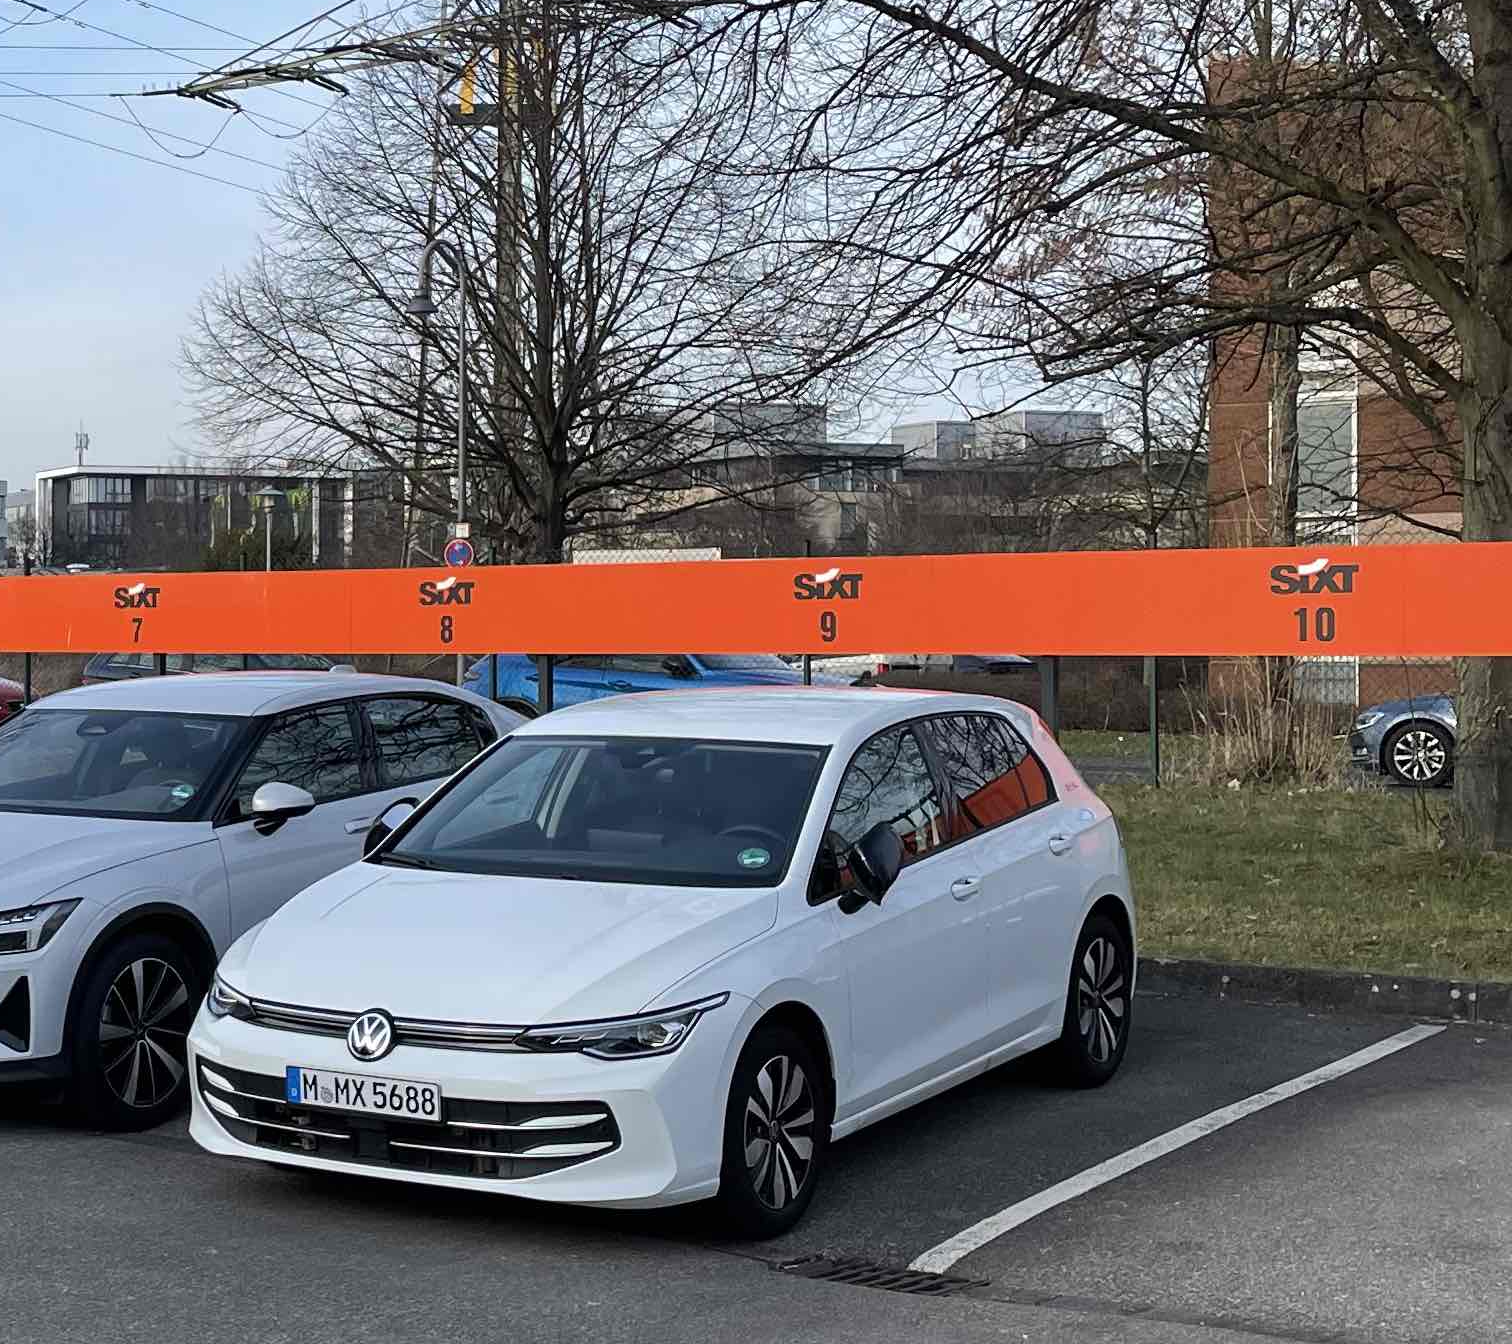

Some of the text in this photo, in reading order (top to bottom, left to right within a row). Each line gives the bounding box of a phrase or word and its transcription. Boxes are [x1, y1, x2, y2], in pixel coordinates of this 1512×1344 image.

[132, 617, 143, 643] 7
[440, 615, 454, 643] 8
[820, 611, 836, 642] 9
[1294, 607, 1336, 641] 10
[302, 1073, 435, 1116] M MX 5688
